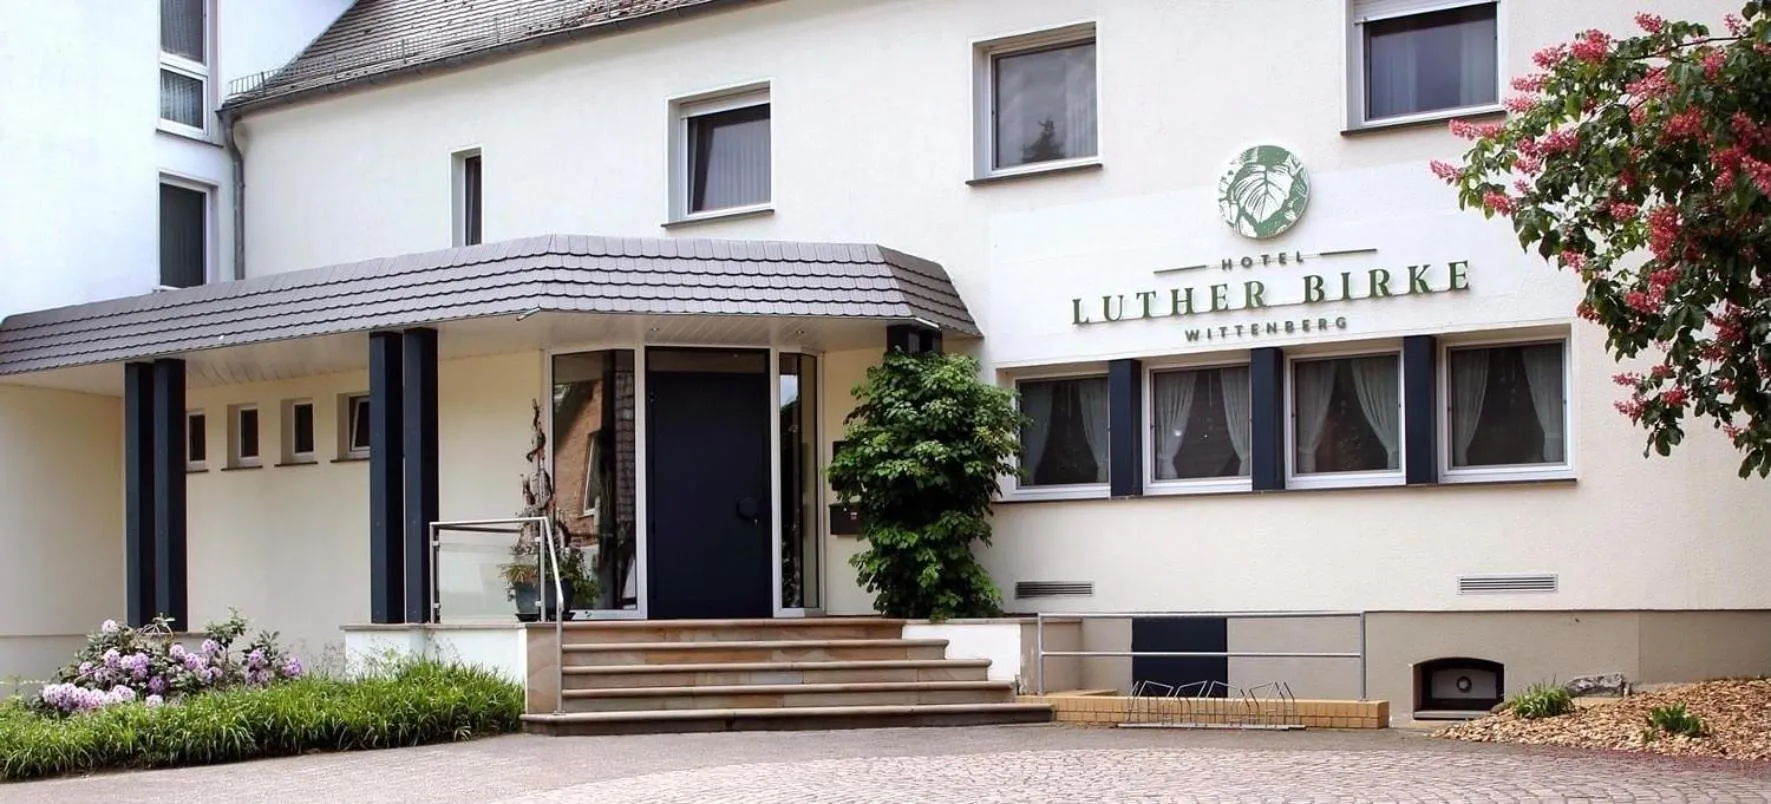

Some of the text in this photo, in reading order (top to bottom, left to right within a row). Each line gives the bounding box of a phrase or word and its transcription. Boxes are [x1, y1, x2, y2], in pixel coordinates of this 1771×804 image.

[1221, 251, 1305, 271] HOTEL
[1072, 260, 1471, 326] LUTHER BIRKE
[1185, 316, 1348, 342] WITTENBERG
